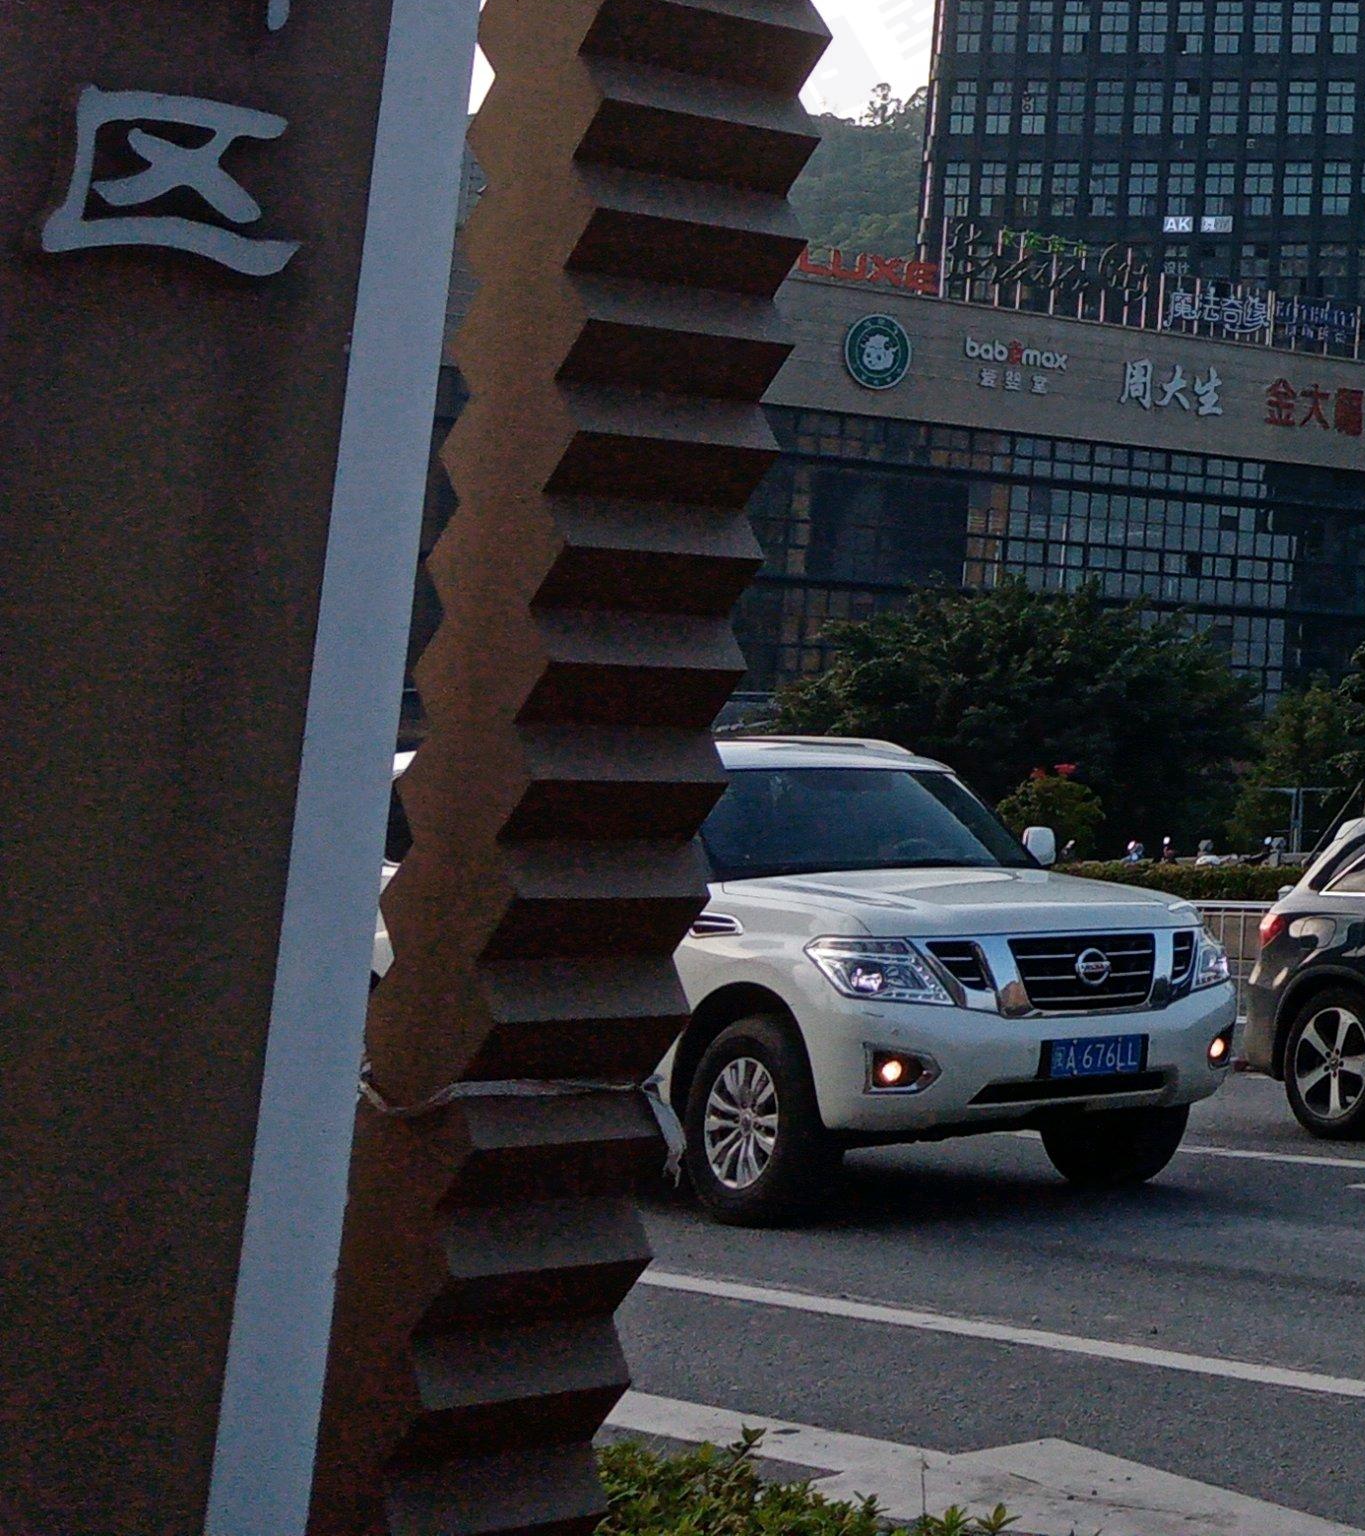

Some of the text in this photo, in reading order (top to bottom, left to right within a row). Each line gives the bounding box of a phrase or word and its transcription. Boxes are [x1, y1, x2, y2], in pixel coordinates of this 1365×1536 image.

[1165, 216, 1190, 232] AK
[799, 247, 940, 293] LUXE
[1163, 289, 1272, 333] 魔法奇缘
[1118, 358, 1224, 417] 周大生
